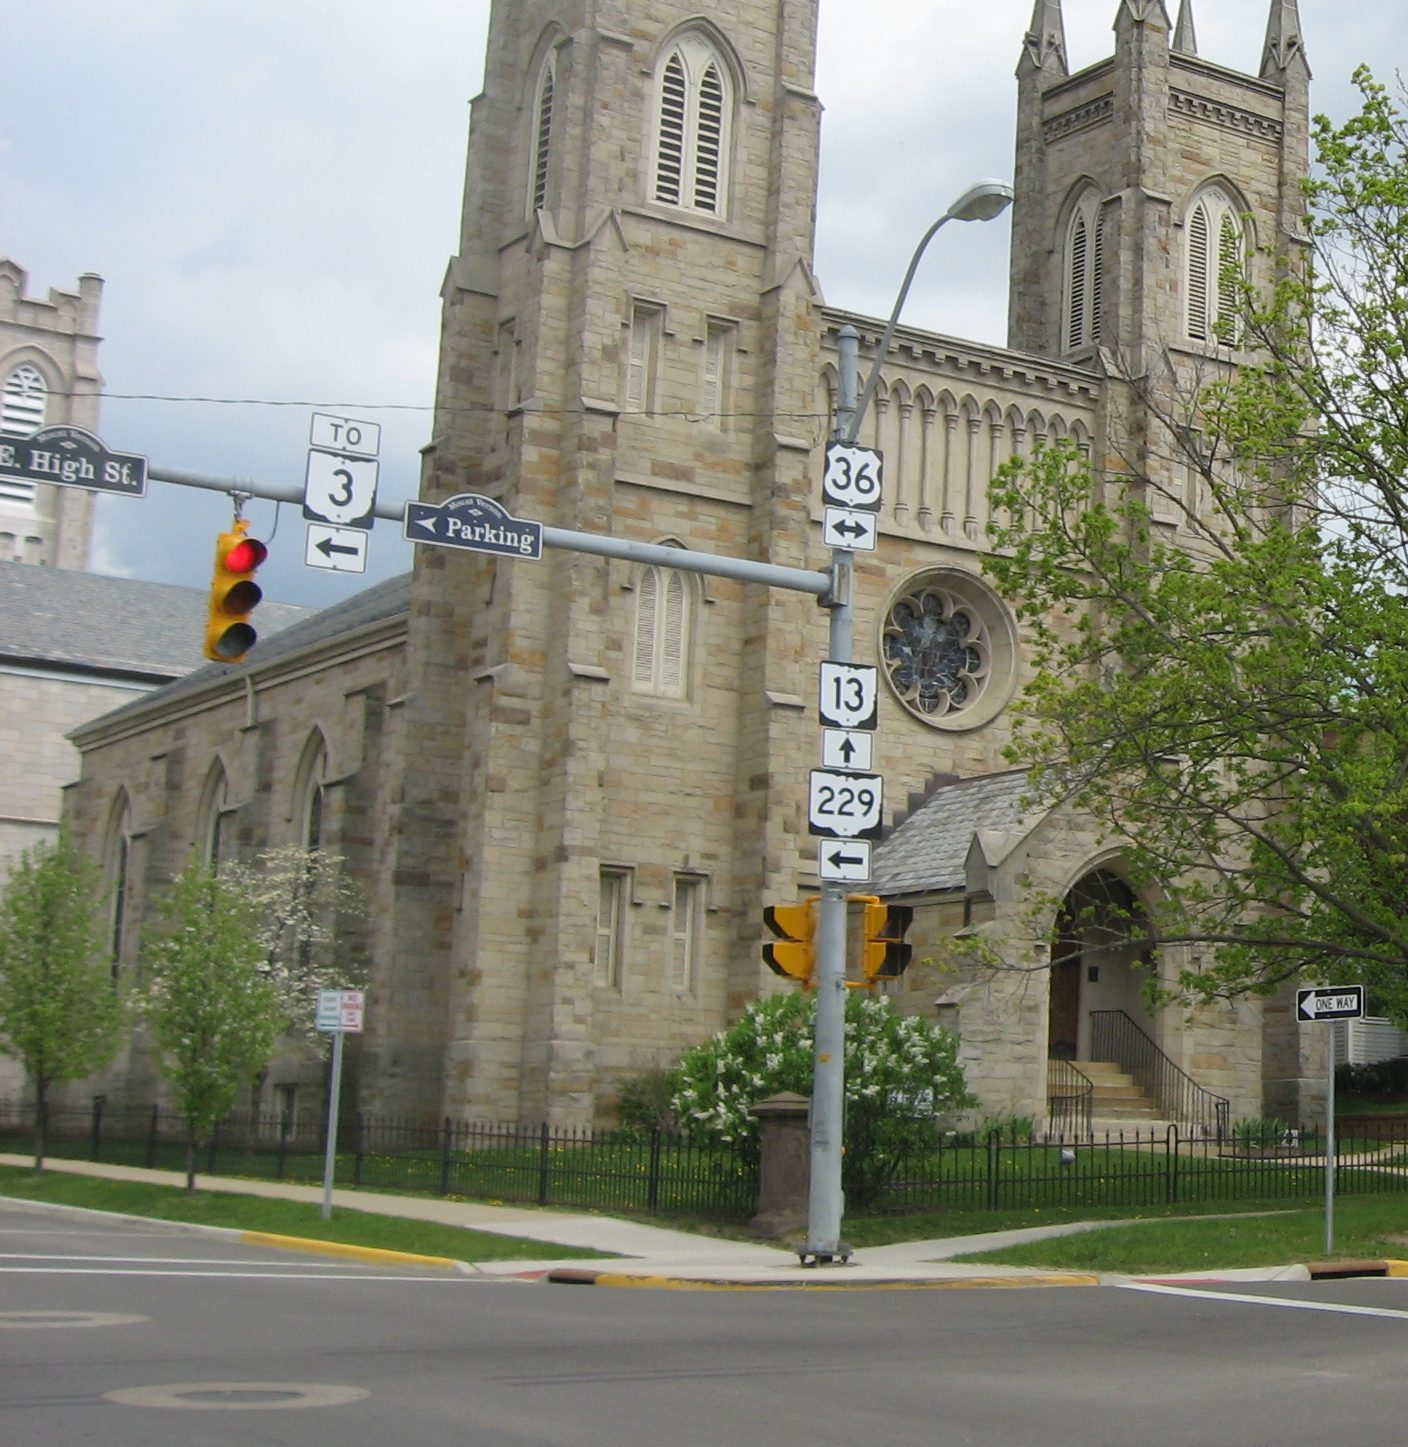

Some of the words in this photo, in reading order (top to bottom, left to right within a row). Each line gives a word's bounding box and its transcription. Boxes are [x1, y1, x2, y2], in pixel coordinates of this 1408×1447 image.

[329, 423, 363, 446] TO
[0, 444, 21, 469] E.
[29, 449, 95, 482] High
[103, 461, 137, 486] St.
[830, 456, 875, 495] 36
[328, 468, 354, 508] 3
[446, 516, 535, 555] Parking
[832, 676, 864, 713] 13
[817, 785, 875, 818] 229
[1316, 997, 1333, 1011] ONE
[1336, 996, 1355, 1009] WAY
